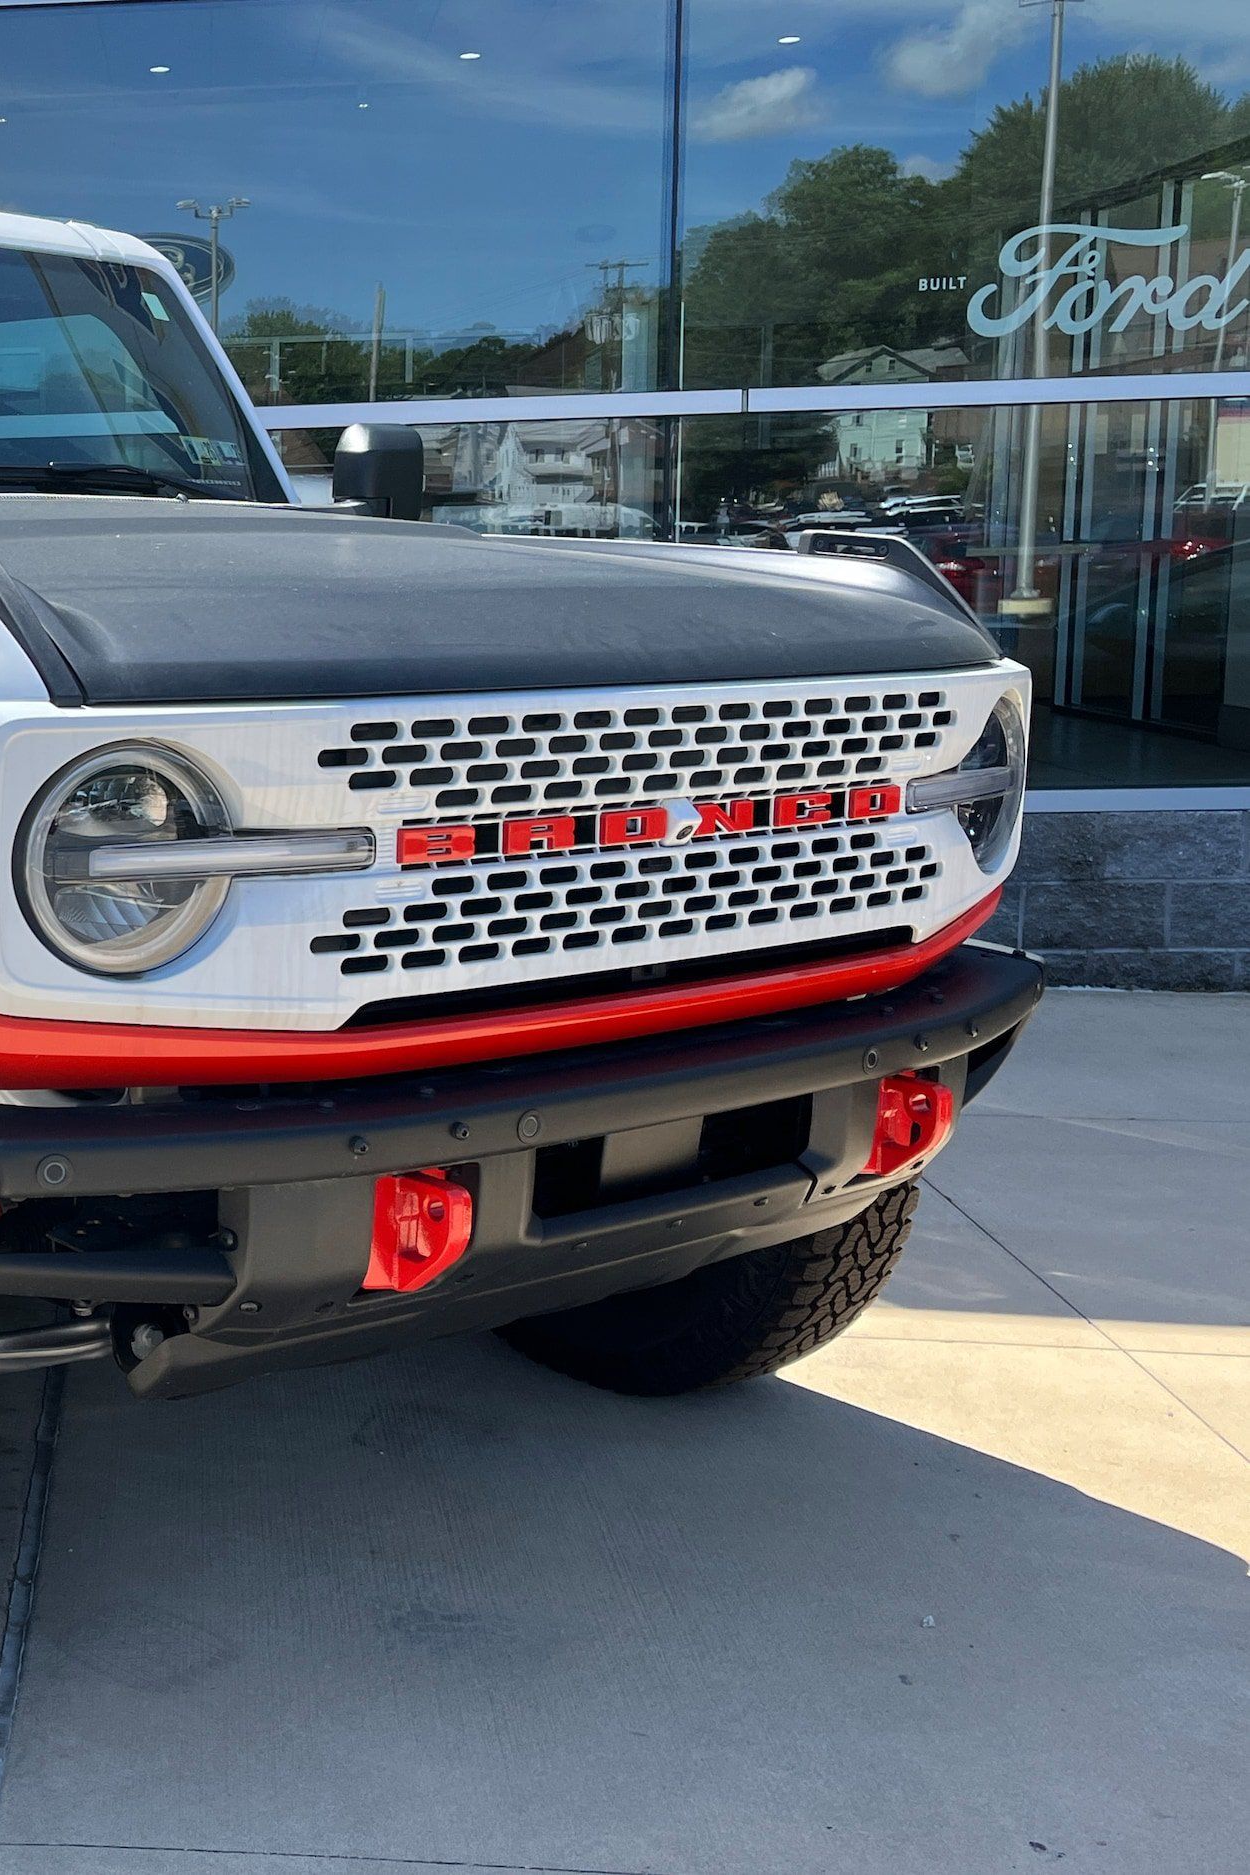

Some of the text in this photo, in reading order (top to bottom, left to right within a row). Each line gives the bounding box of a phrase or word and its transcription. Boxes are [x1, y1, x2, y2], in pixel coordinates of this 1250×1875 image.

[918, 223, 1250, 338] BUILT Ford
[396, 783, 901, 865] BRONCO
